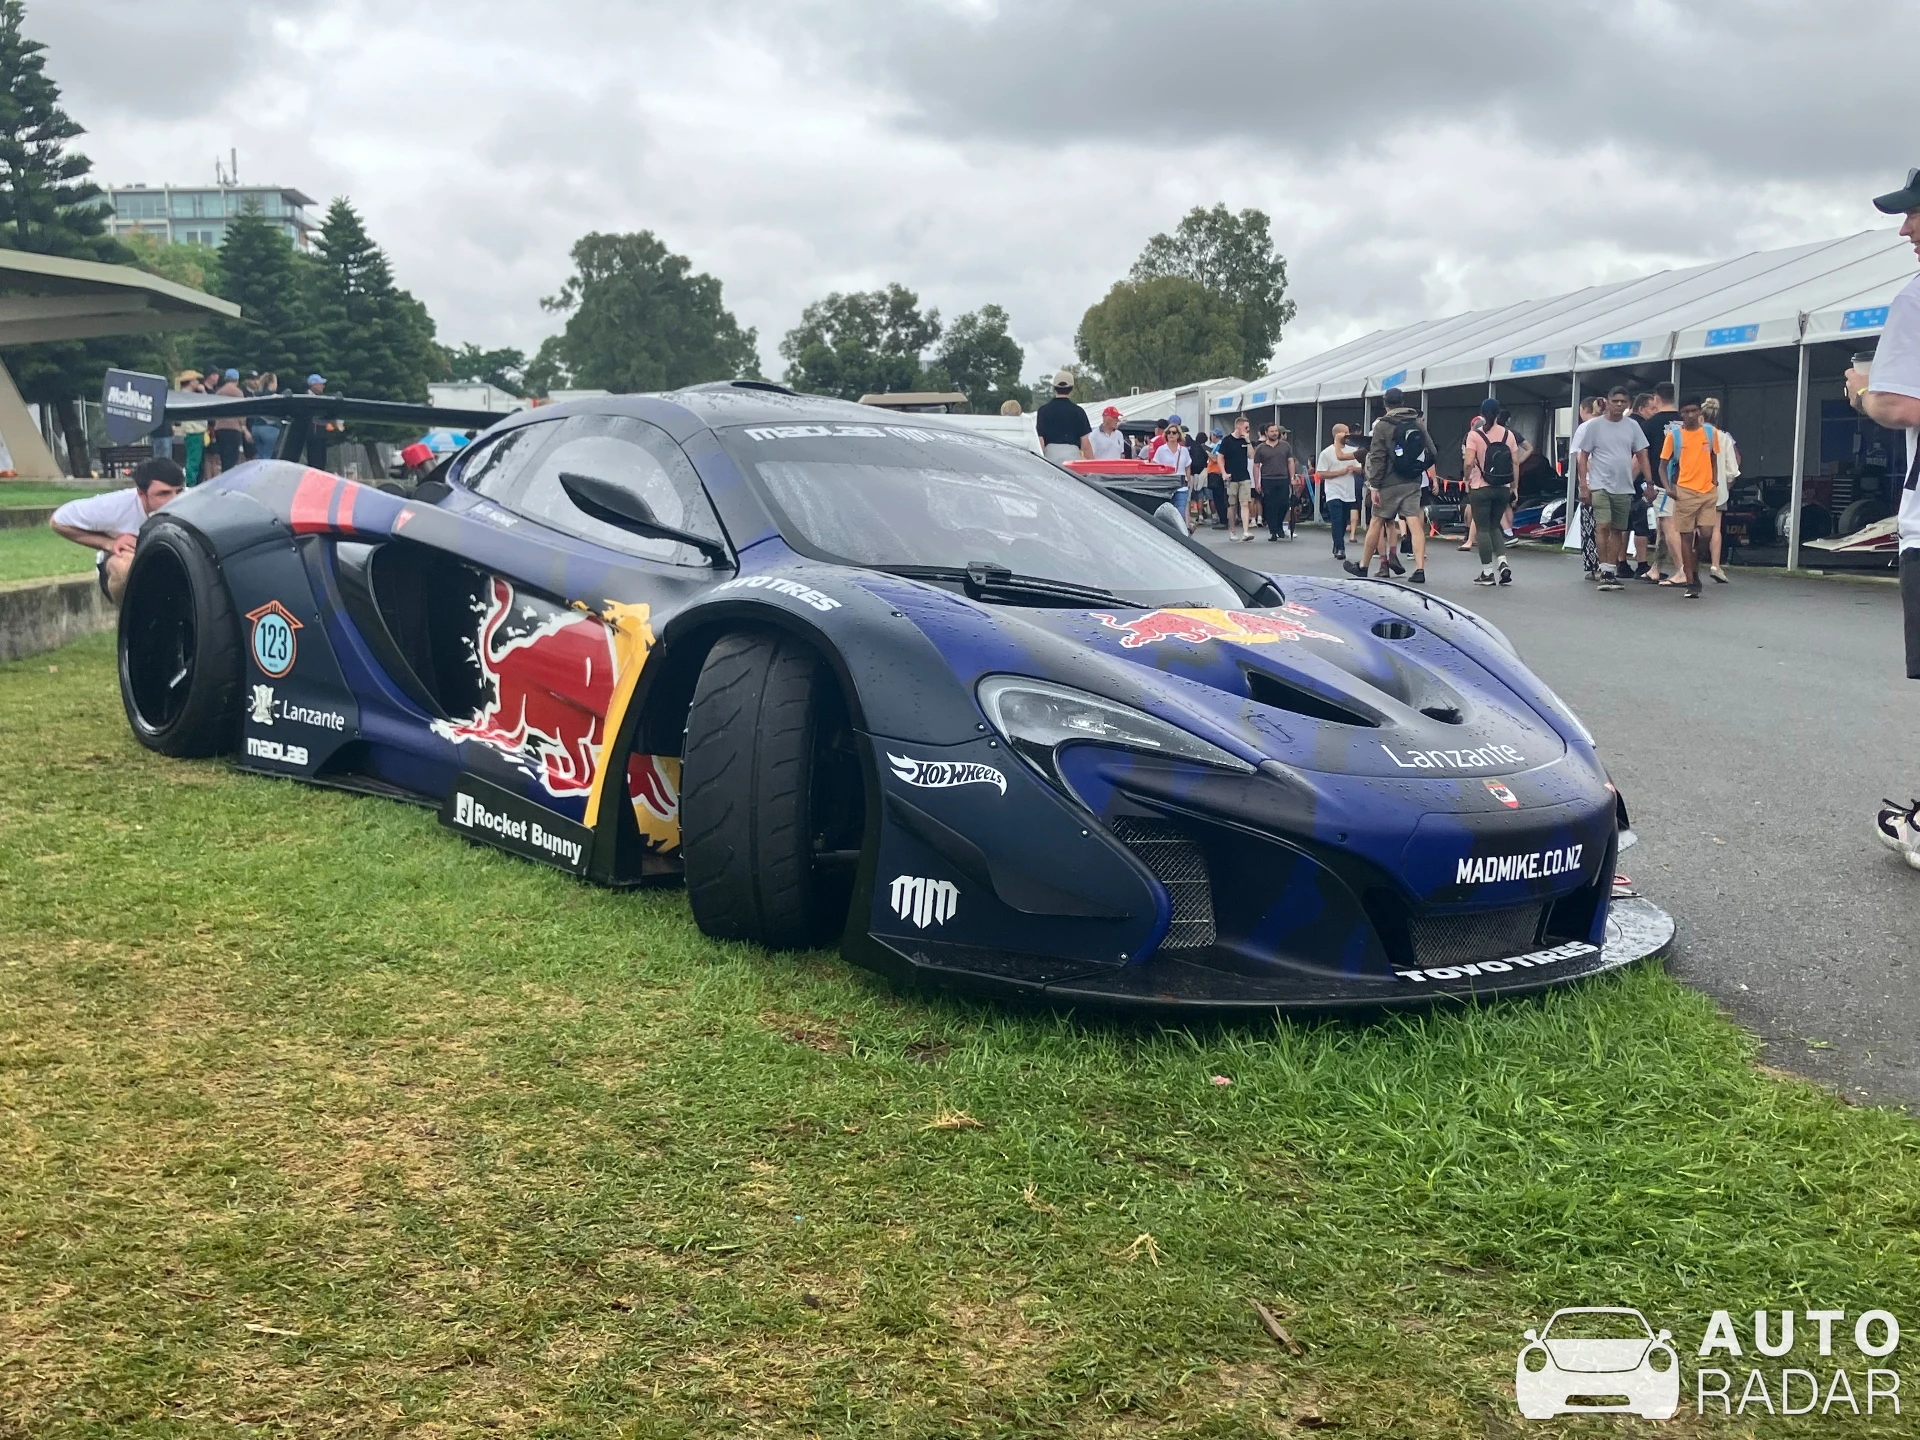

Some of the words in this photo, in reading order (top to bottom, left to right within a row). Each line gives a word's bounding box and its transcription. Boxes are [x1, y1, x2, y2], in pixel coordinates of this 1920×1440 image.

[765, 578, 843, 611] TIRES
[260, 622, 288, 661] 123
[282, 699, 345, 732] Lanzante
[1381, 743, 1525, 768] Lanzante
[474, 803, 528, 841] Rocket
[531, 822, 582, 866] Bunny
[1455, 843, 1583, 885] MADMIKE.CO.NZ
[1394, 960, 1513, 982] TOYO
[1502, 940, 1599, 968] TIRES
